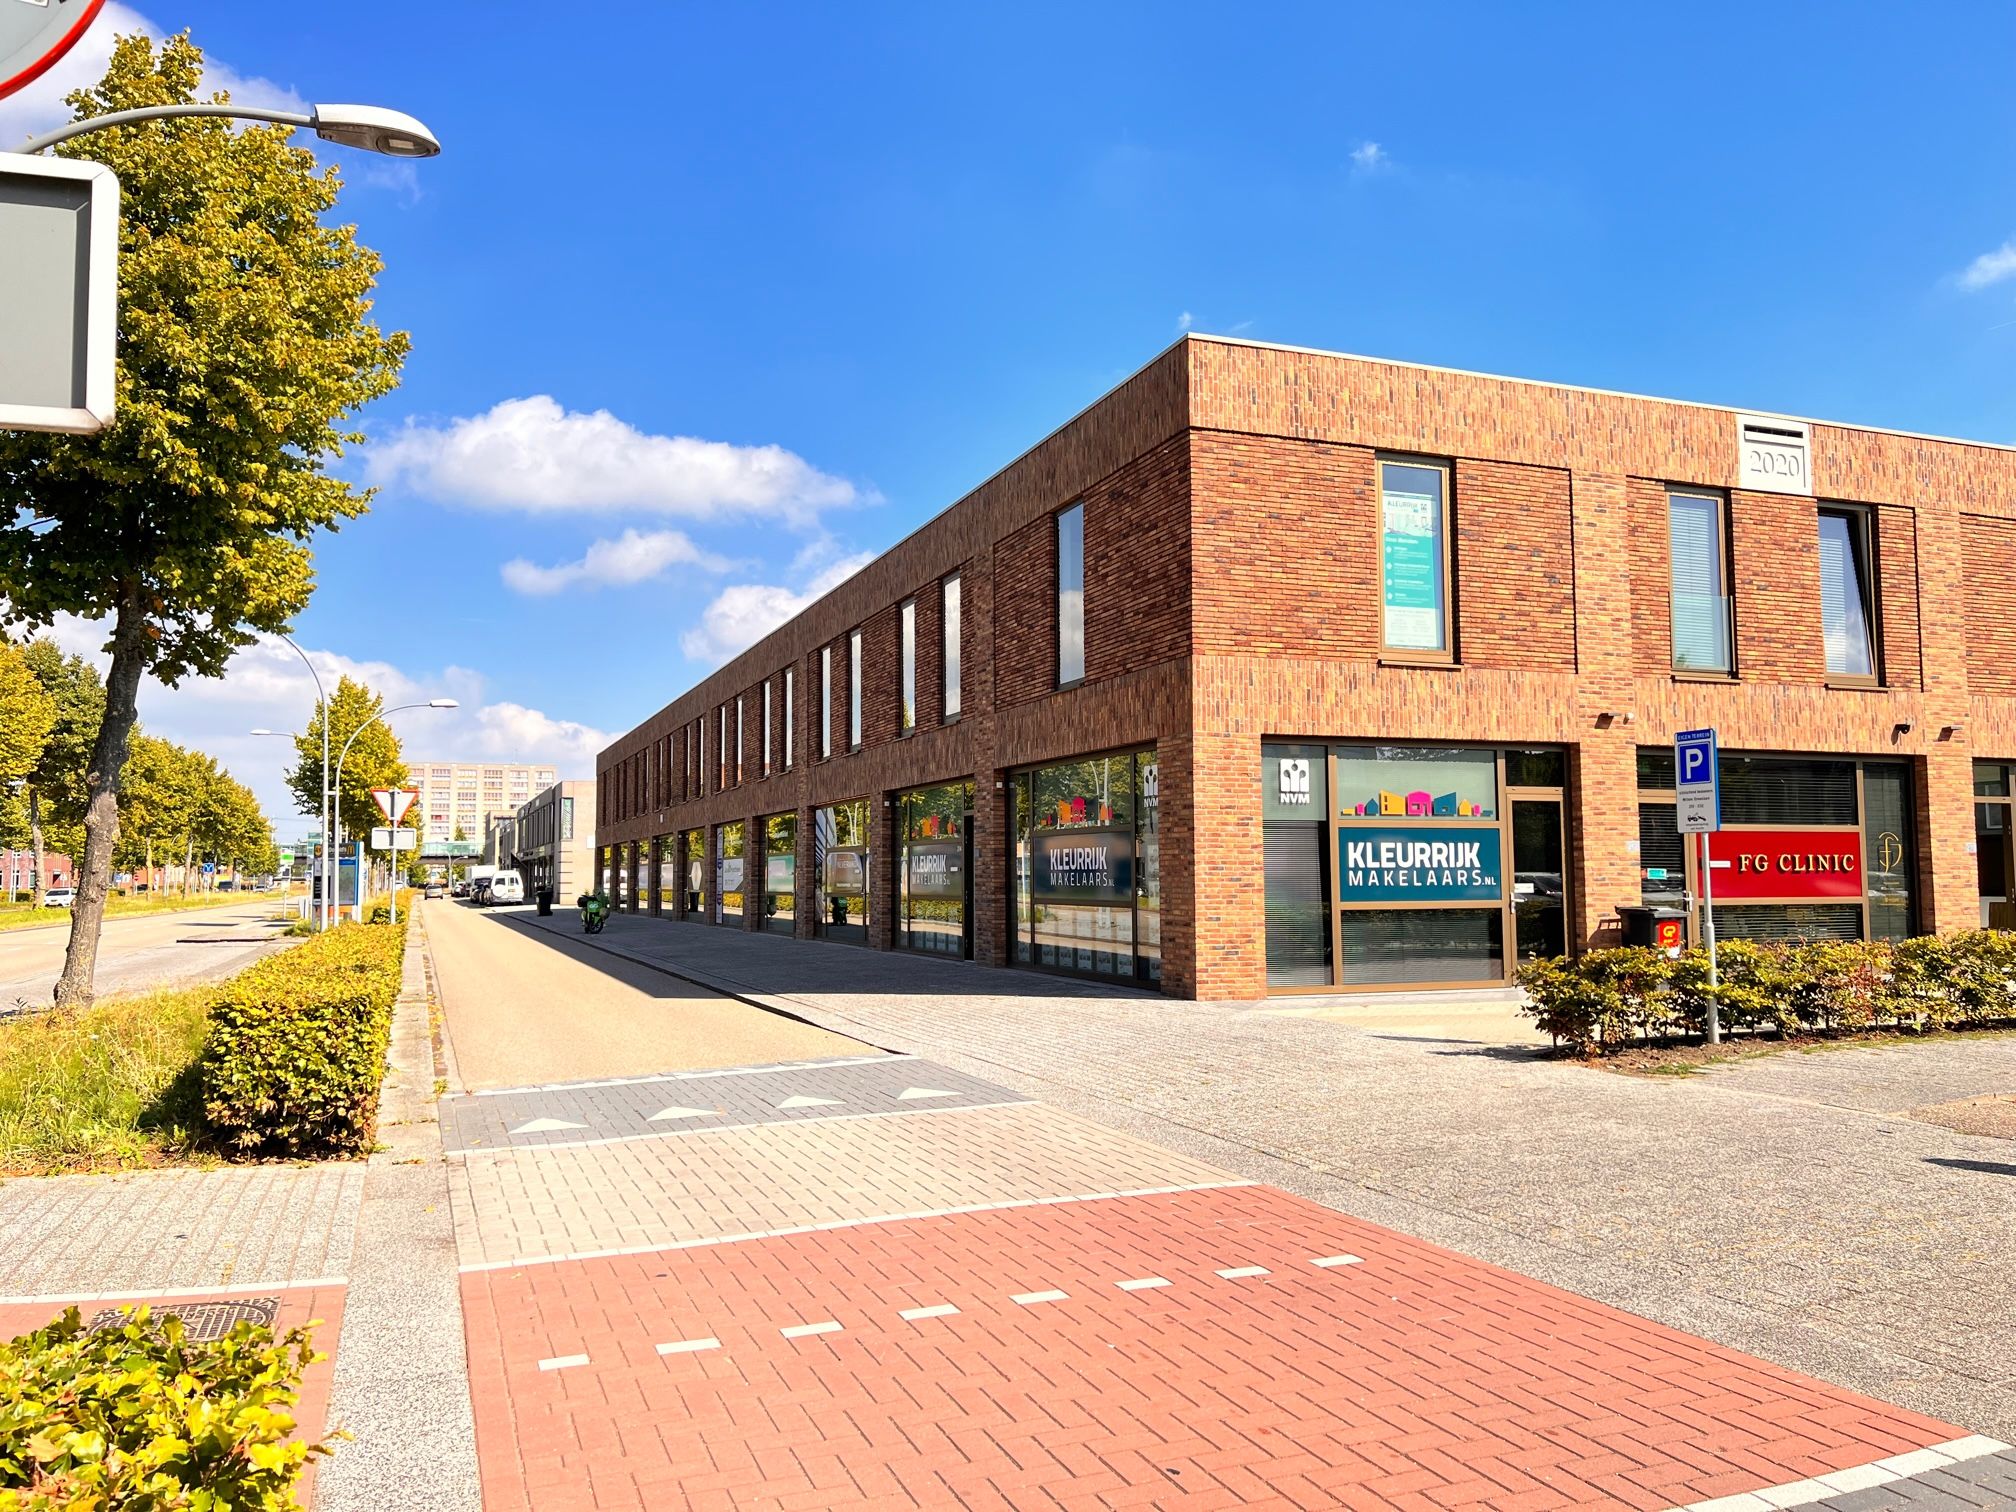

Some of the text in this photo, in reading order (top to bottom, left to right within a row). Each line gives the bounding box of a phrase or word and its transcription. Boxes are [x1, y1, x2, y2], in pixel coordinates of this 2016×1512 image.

[1750, 450, 1800, 477] 2020
[1685, 748, 1703, 780] P
[1144, 798, 1158, 808] NVM
[1280, 793, 1310, 804] NVM
[911, 854, 947, 873] KLEURRIJK
[1050, 846, 1108, 871] KLEURRIJK
[1347, 841, 1481, 868] KLEURRIJK
[1740, 854, 1855, 872] FG CLINIC
